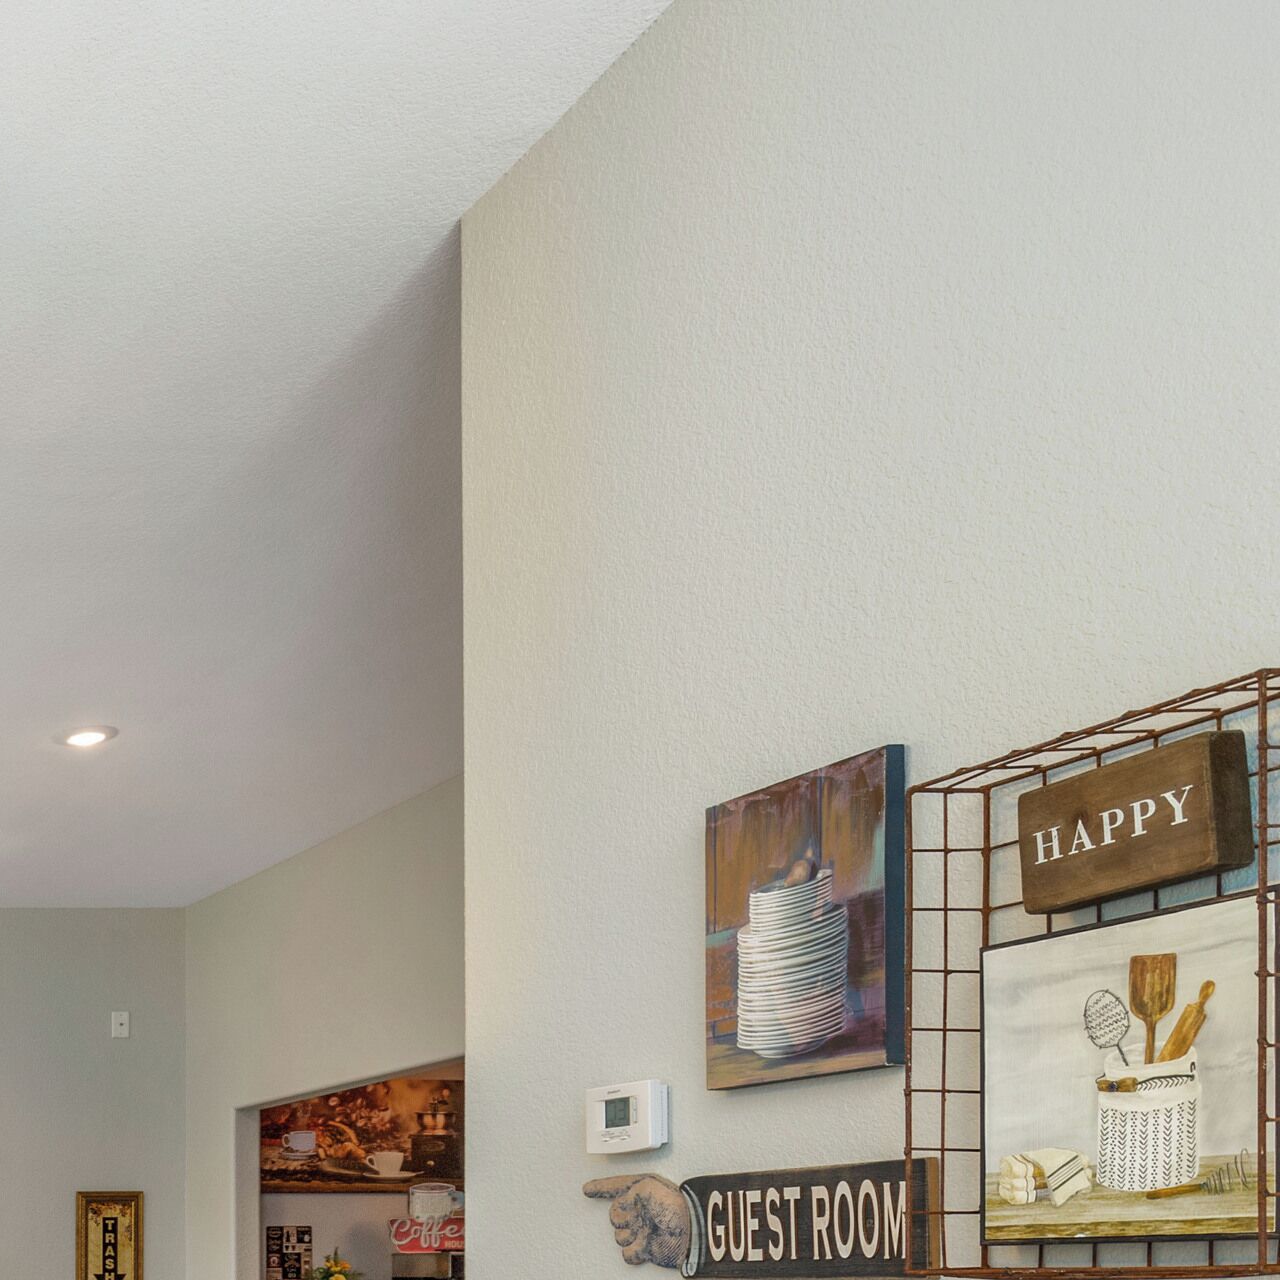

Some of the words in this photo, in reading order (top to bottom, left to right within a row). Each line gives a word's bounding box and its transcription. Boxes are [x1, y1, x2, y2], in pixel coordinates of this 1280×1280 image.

[1032, 784, 1194, 865] HAPPY
[391, 1215, 464, 1248] Coffe
[445, 1240, 464, 1249] HOU
[707, 1185, 801, 1262] GUEST
[811, 1179, 906, 1261] ROOM
